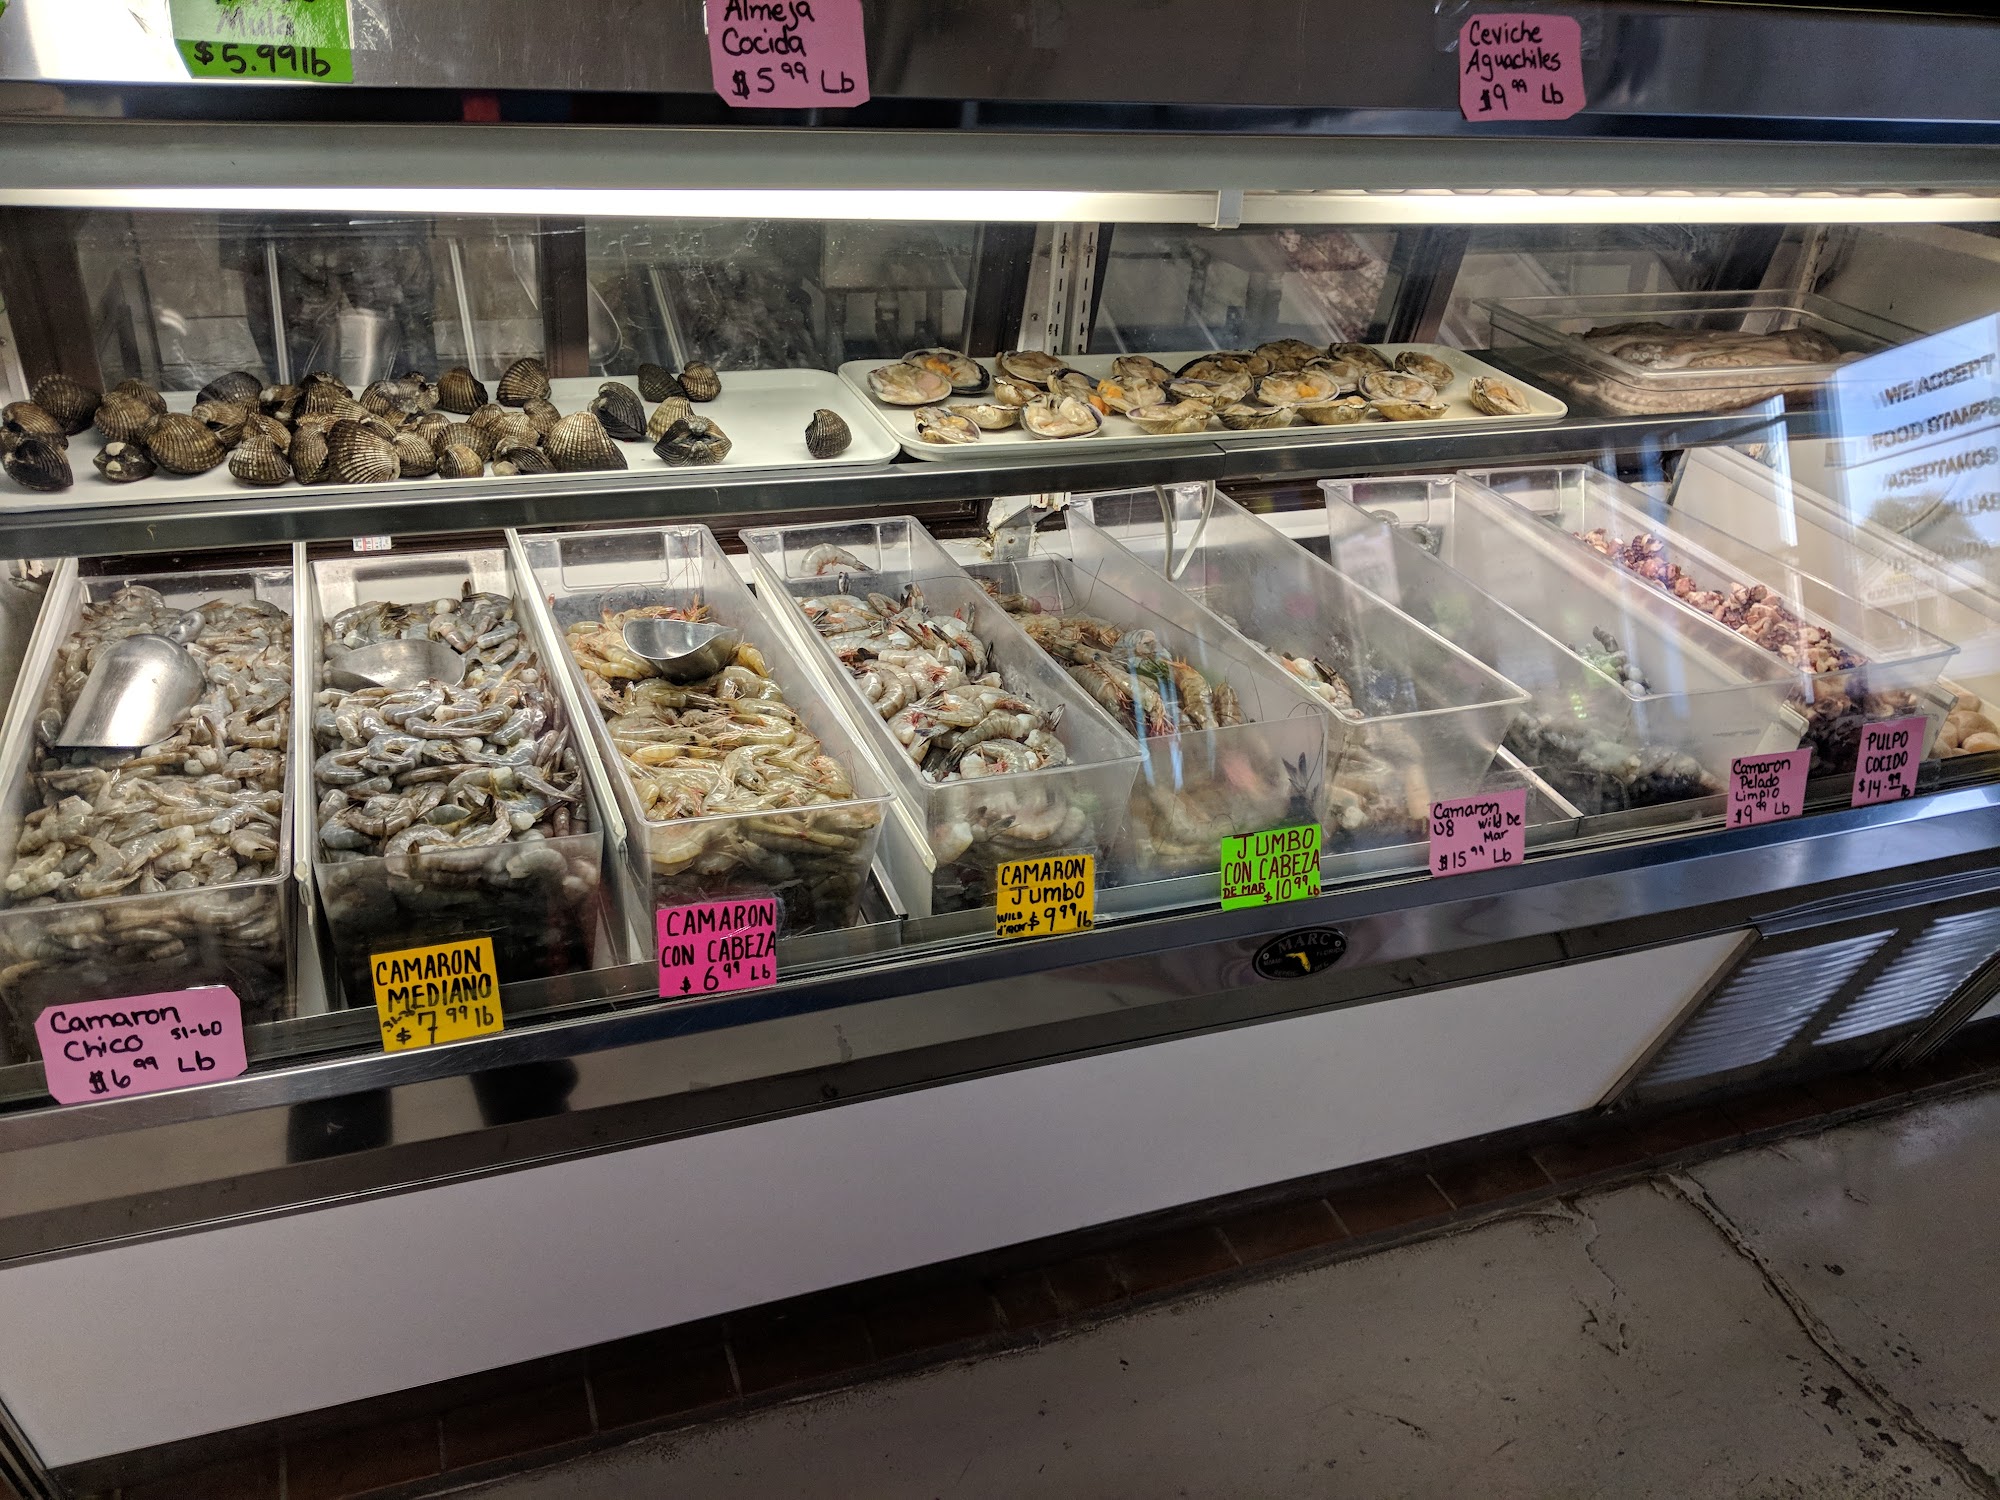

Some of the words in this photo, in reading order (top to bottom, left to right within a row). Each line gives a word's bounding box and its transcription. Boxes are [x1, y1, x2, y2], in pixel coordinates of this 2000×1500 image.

[723, 0, 815, 31] Almeja
[722, 24, 807, 57] Cocida
[1469, 20, 1543, 46] Ceviche
[1465, 47, 1561, 82] Aguachiles
[821, 70, 855, 94] Lb
[1542, 83, 1564, 104] Lb
[1872, 421, 1924, 451] FOOD
[1866, 730, 1909, 751] PULPO
[1733, 759, 1791, 775] Camaron
[1866, 751, 1909, 774] COCIDO
[1740, 773, 1780, 789] Pelado
[1433, 802, 1499, 820] Camaron
[1774, 801, 1790, 815] Lb
[1232, 828, 1314, 859] JUMBO
[1483, 829, 1509, 843] Mar
[1225, 860, 1252, 886] CON
[1259, 849, 1320, 880] CABEZA
[1493, 847, 1512, 864] Lb
[1001, 858, 1086, 886] CAMARON
[1222, 886, 1237, 899] DE
[666, 903, 774, 937] CAMARON
[997, 911, 1023, 923] WILD
[661, 944, 694, 968] CON
[707, 930, 776, 963] CABEZA
[1278, 932, 1331, 953] MARC
[376, 946, 482, 986] CAMARON
[751, 964, 771, 981] Lb
[388, 973, 492, 1013] MEDIANO
[50, 1006, 181, 1034] Camaron
[64, 1034, 143, 1061] Chico
[178, 1050, 216, 1073] Lb
